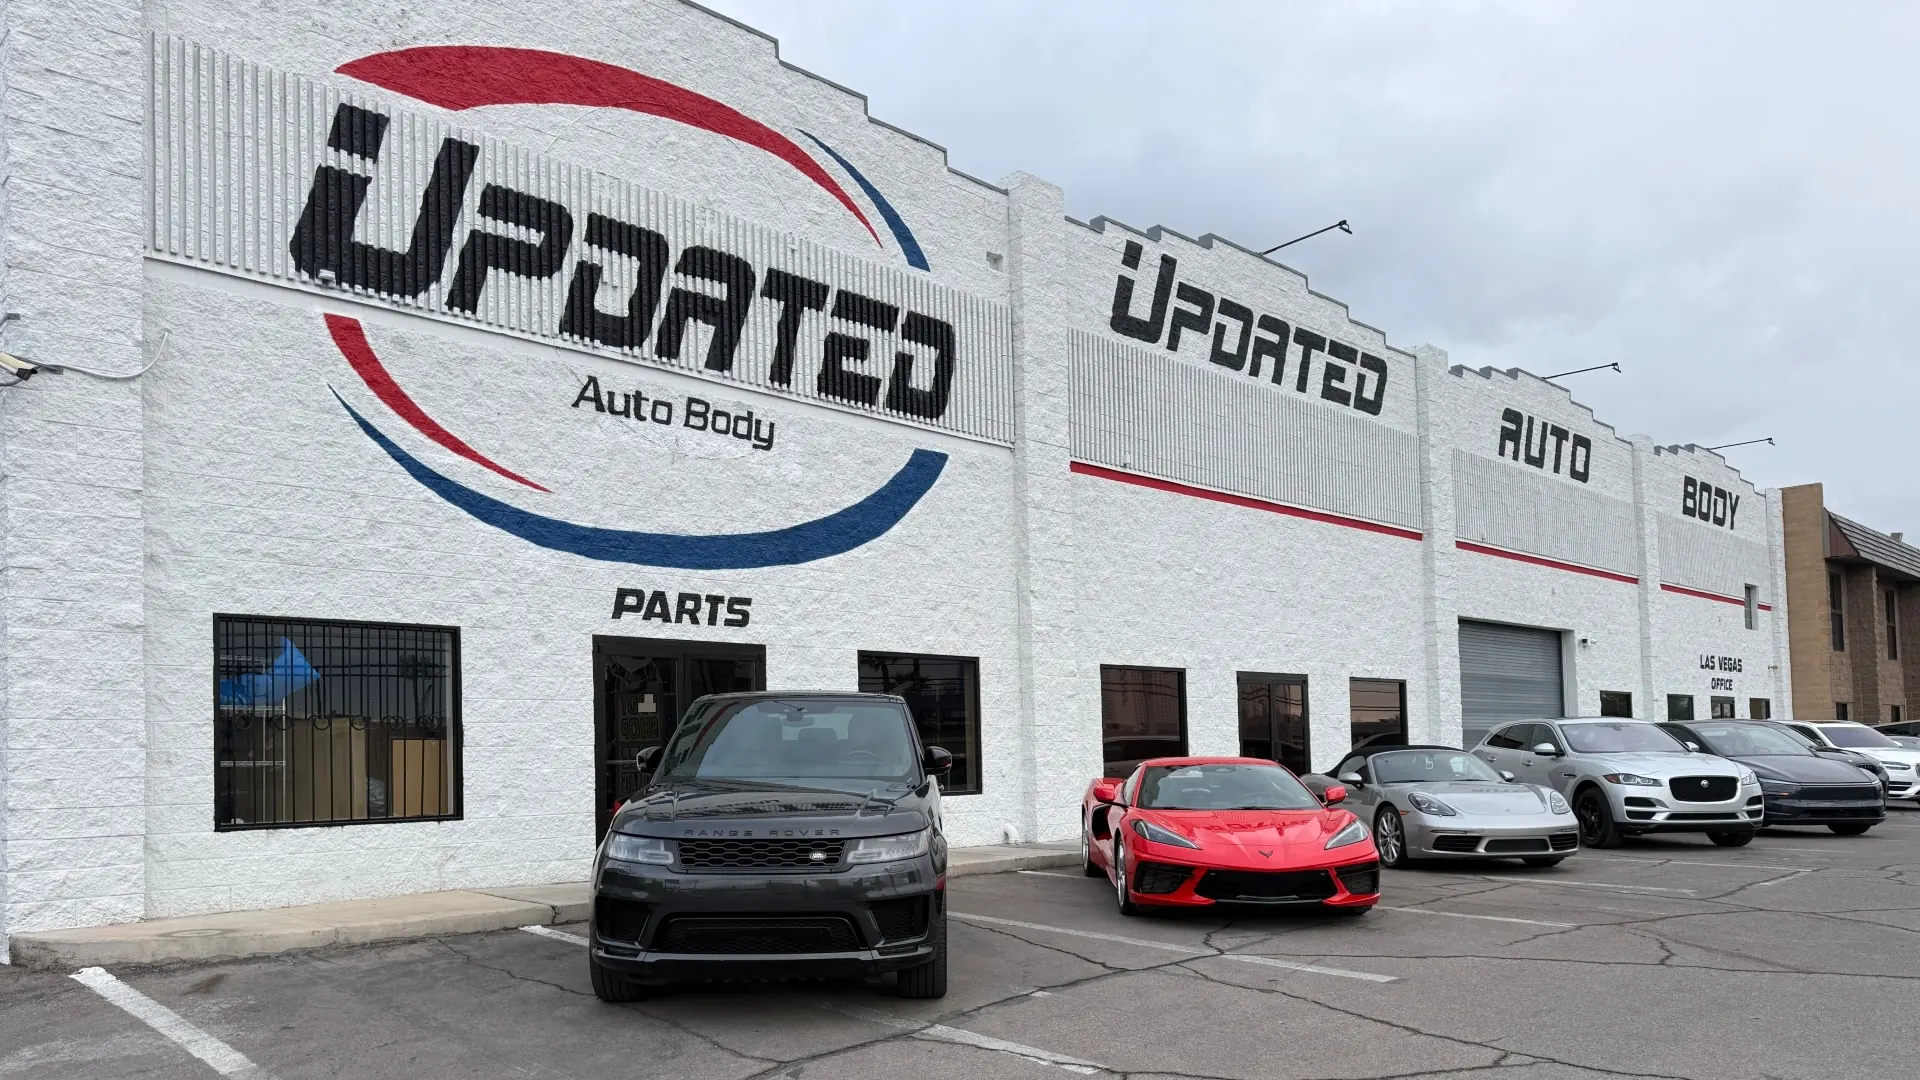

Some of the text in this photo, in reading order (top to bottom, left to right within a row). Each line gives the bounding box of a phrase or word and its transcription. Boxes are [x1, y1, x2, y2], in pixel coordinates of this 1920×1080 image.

[290, 103, 954, 420] UPDATED
[1110, 240, 1740, 529] UPDATED AUTO BODY
[572, 376, 775, 451] Auto Body
[612, 588, 752, 627] PARTS
[1700, 654, 1742, 672] LAS VEGAS
[1711, 678, 1733, 690] OFFICE
[684, 829, 840, 837] RANGE ROVER
